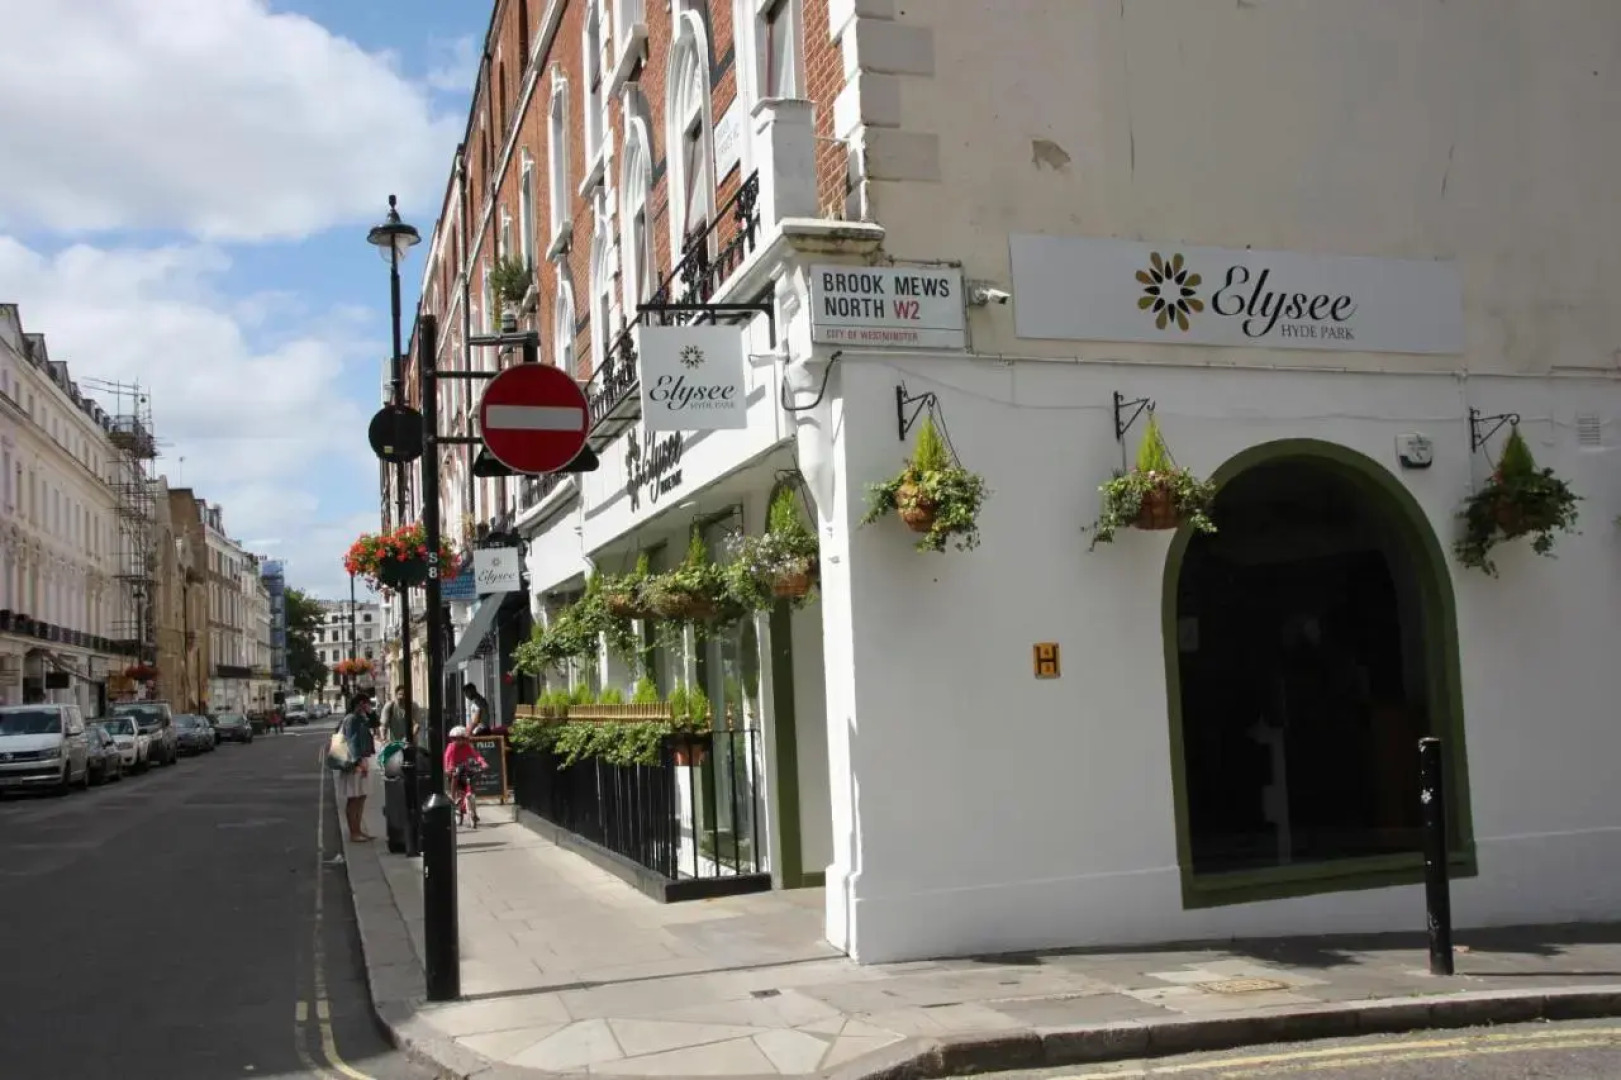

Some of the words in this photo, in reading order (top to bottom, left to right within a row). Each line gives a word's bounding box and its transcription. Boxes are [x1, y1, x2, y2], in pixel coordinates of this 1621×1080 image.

[823, 272, 885, 295] BROOK
[894, 276, 950, 298] MEWS
[824, 297, 885, 319] NORTH
[893, 300, 921, 320] W2
[1211, 265, 1358, 338] Elysee
[826, 328, 845, 340] CITY
[847, 330, 858, 341] OF
[860, 330, 918, 343] WESTMINSTER
[1281, 324, 1318, 338] HYDE
[1321, 327, 1356, 340] PARK
[649, 375, 736, 411] Elysee
